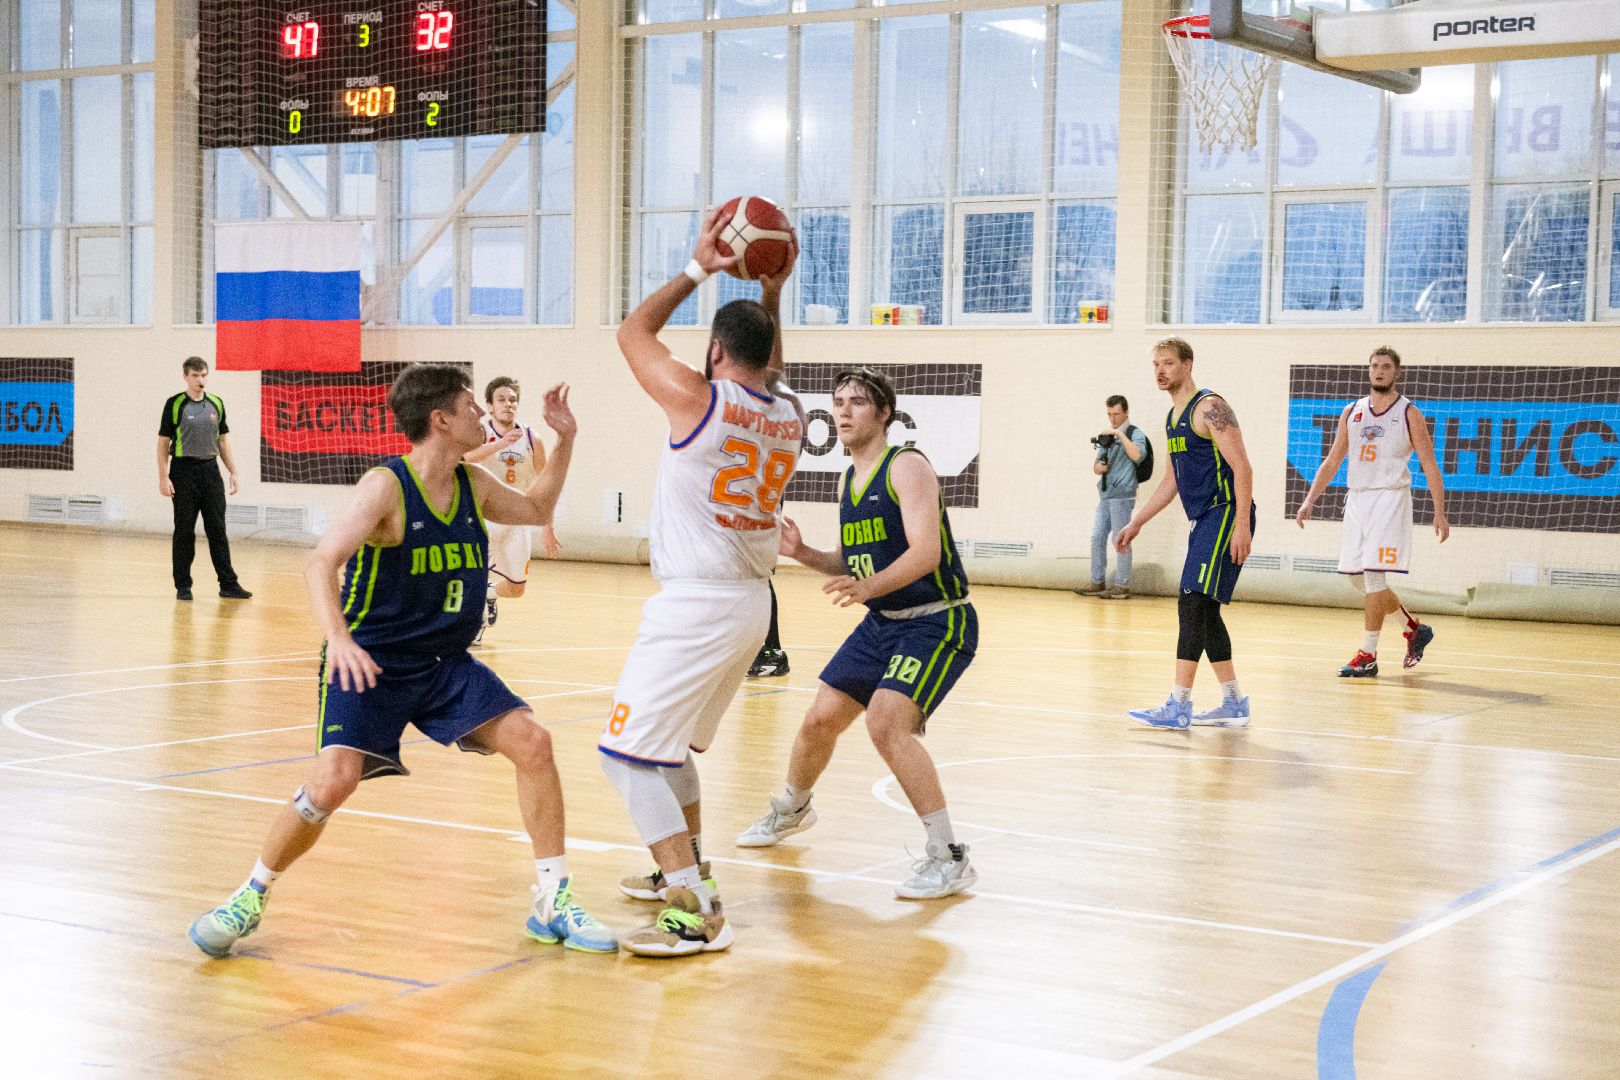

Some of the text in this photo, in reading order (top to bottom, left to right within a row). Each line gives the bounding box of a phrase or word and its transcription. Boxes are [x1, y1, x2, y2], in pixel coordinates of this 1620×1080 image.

[418, 1, 444, 11] СЧЕТ
[286, 12, 311, 23] СЧЕТ
[344, 11, 383, 24] ПЕРИОД
[284, 22, 319, 57] 47
[359, 24, 370, 47] 3
[416, 11, 454, 50] 32
[345, 75, 379, 87] ВРЕМЯ
[345, 86, 396, 117] 4:07
[417, 91, 449, 101] ФОЛЫ
[289, 111, 301, 133] 0
[426, 102, 440, 127] 2
[0, 401, 63, 433] БОЛ
[1359, 444, 1377, 462] 15
[506, 469, 516, 484] 6
[709, 435, 796, 514] 28
[847, 553, 876, 580] 30
[1379, 547, 1397, 564] 15
[1198, 562, 1207, 583] 1
[443, 579, 464, 613] 8
[883, 654, 922, 685] 30
